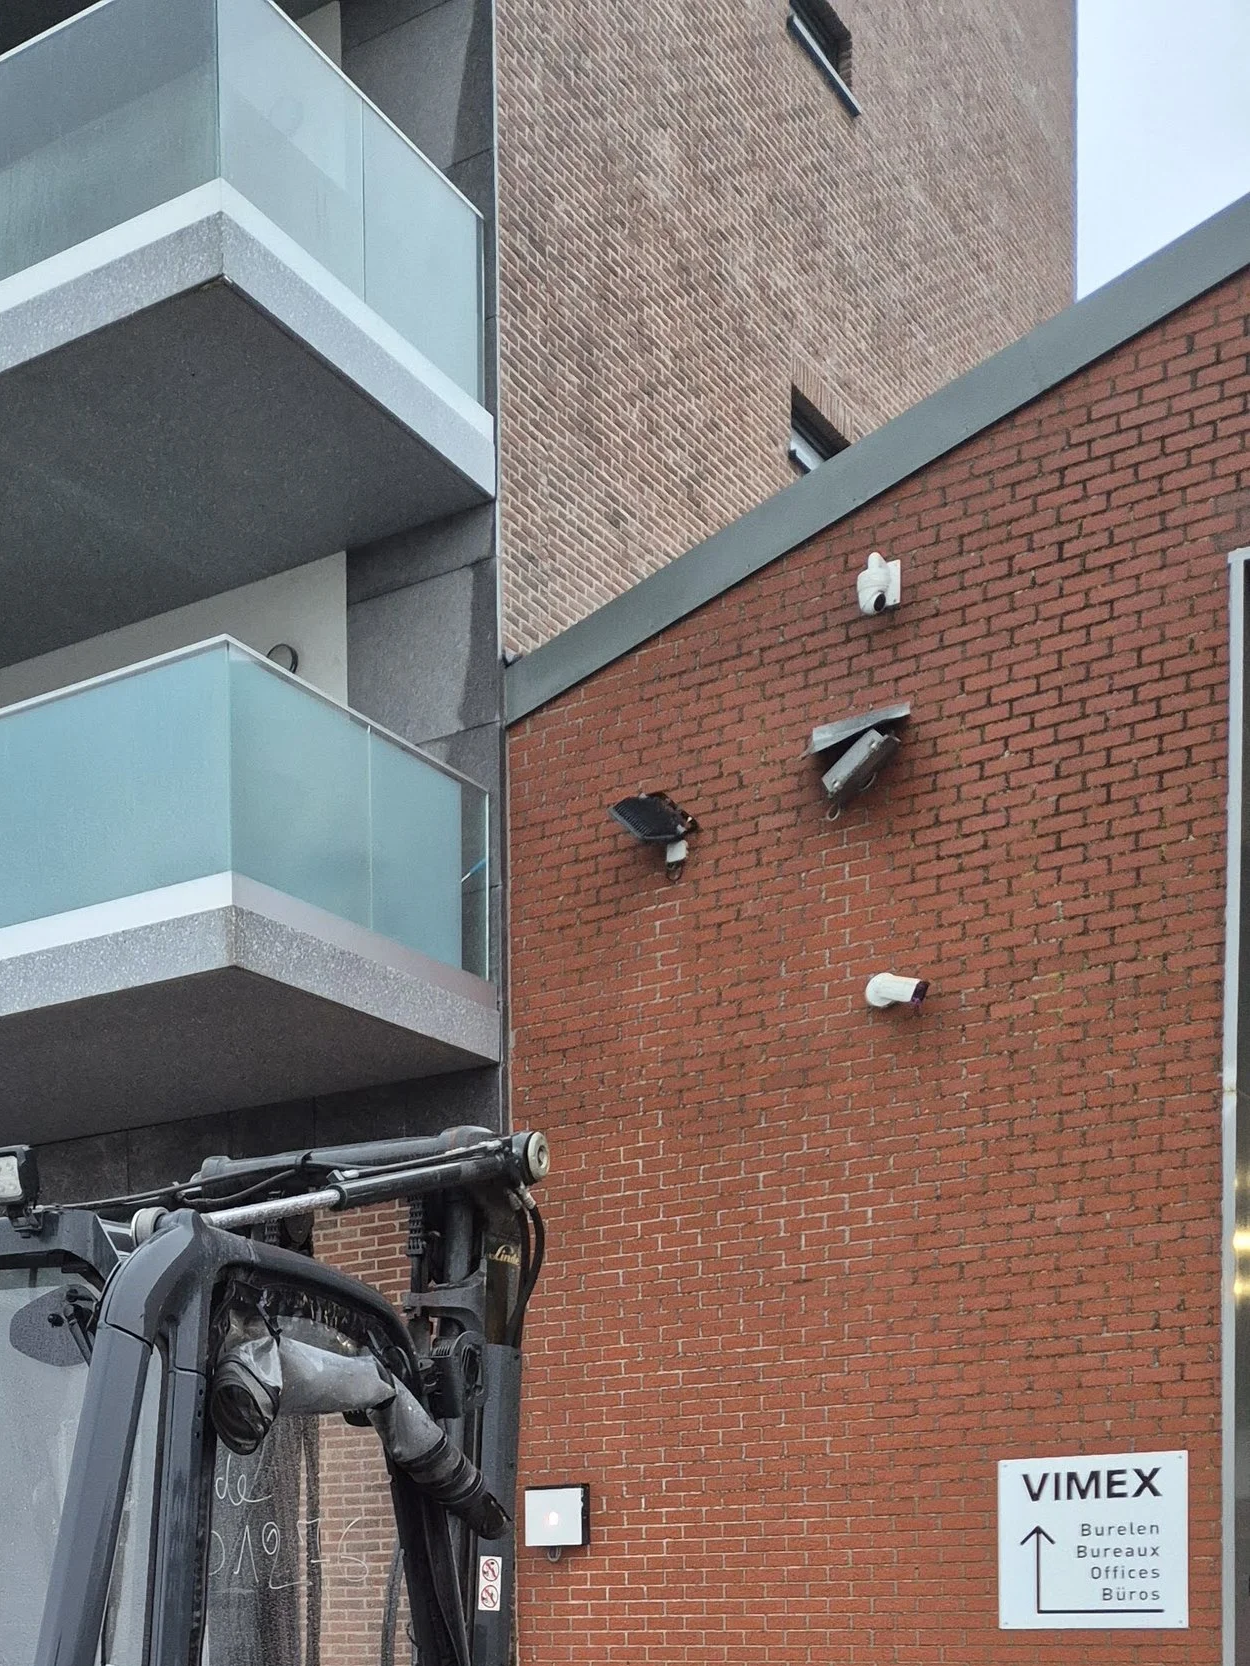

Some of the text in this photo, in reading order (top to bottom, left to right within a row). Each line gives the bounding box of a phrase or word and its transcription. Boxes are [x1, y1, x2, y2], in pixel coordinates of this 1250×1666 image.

[1022, 1467, 1163, 1502] VIMEX
[1080, 1521, 1161, 1537] Burelen
[1076, 1545, 1161, 1559] Bureaux
[1090, 1565, 1161, 1580] Offices
[1102, 1586, 1161, 1602] Büros
